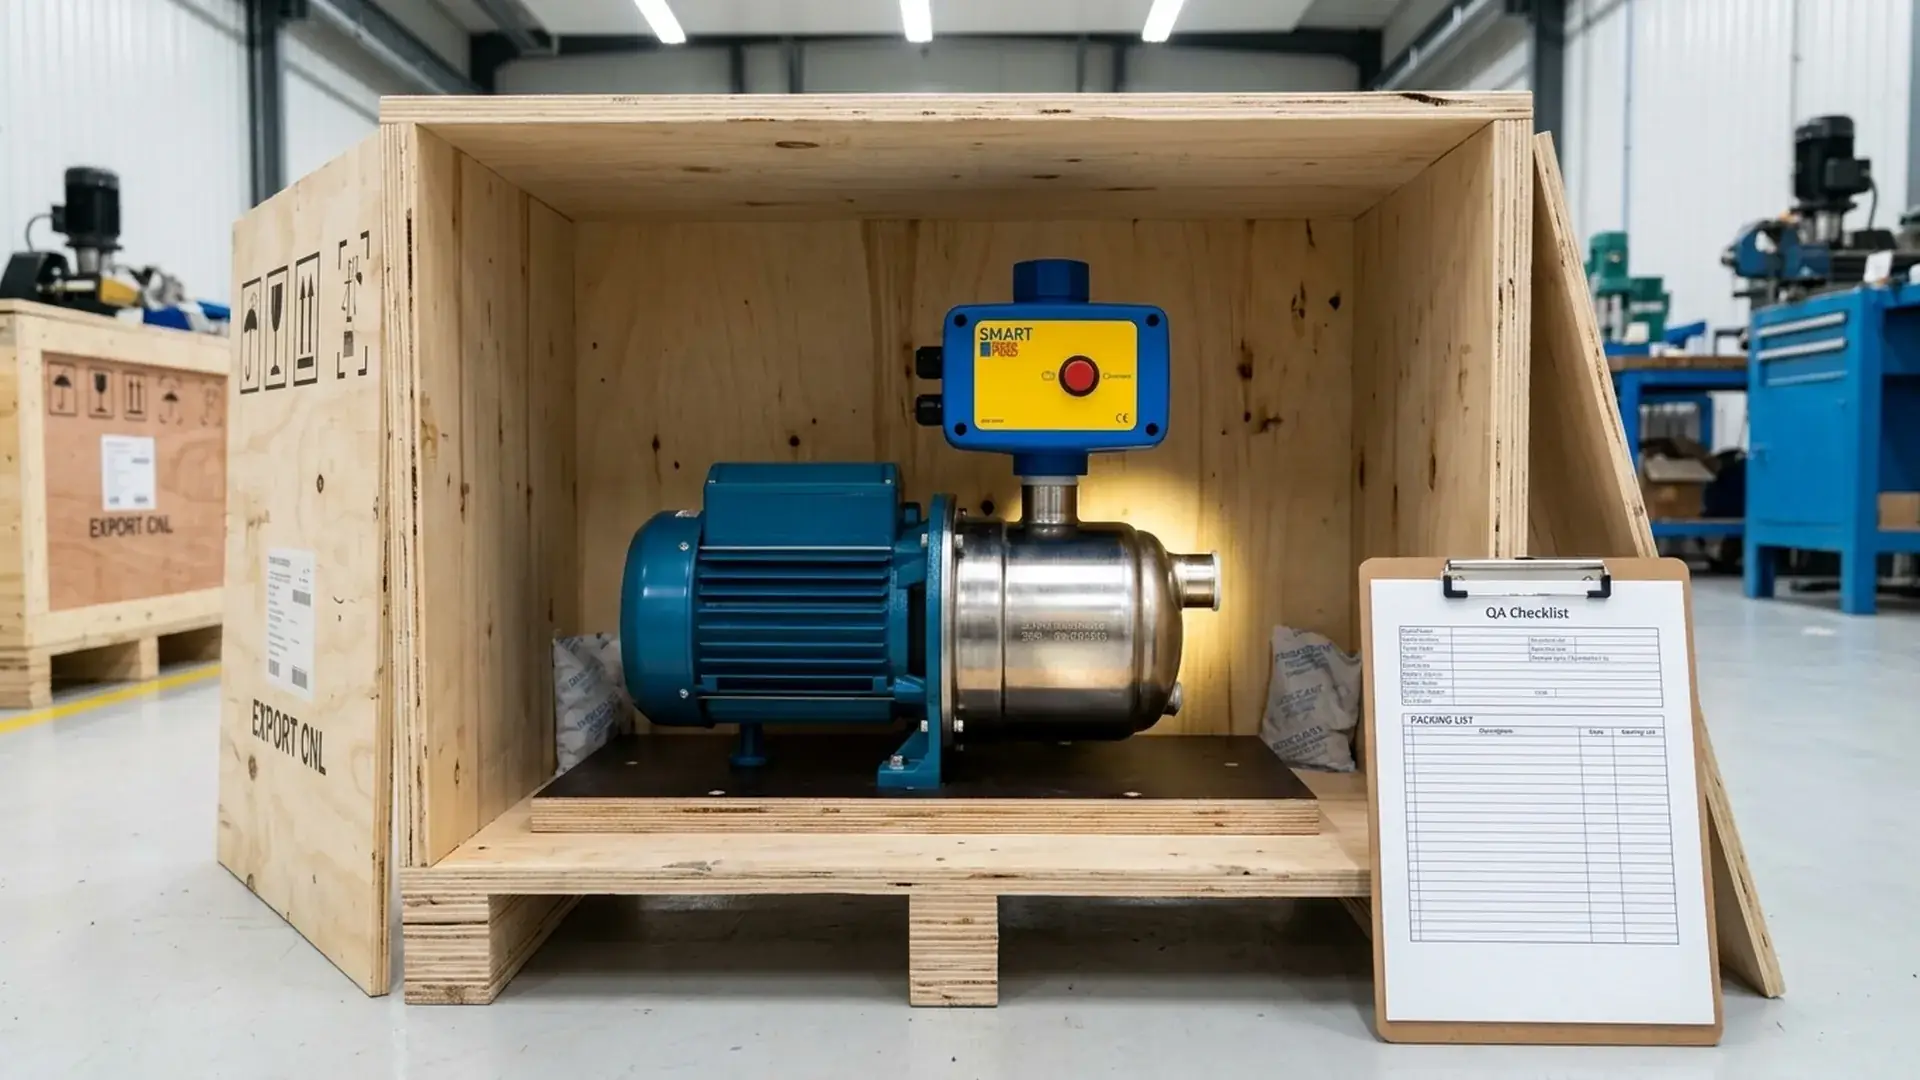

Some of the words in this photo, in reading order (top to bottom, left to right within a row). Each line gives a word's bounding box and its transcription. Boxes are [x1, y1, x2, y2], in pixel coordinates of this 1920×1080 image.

[980, 327, 1033, 341] SMART
[89, 516, 143, 538] EXPORT
[1485, 606, 1507, 620] QA
[1509, 606, 1570, 619] Checklist
[1410, 715, 1453, 725] PACKING
[1454, 715, 1474, 725] LIST
[252, 698, 298, 757] EXPORT
[301, 722, 326, 776] CNL
